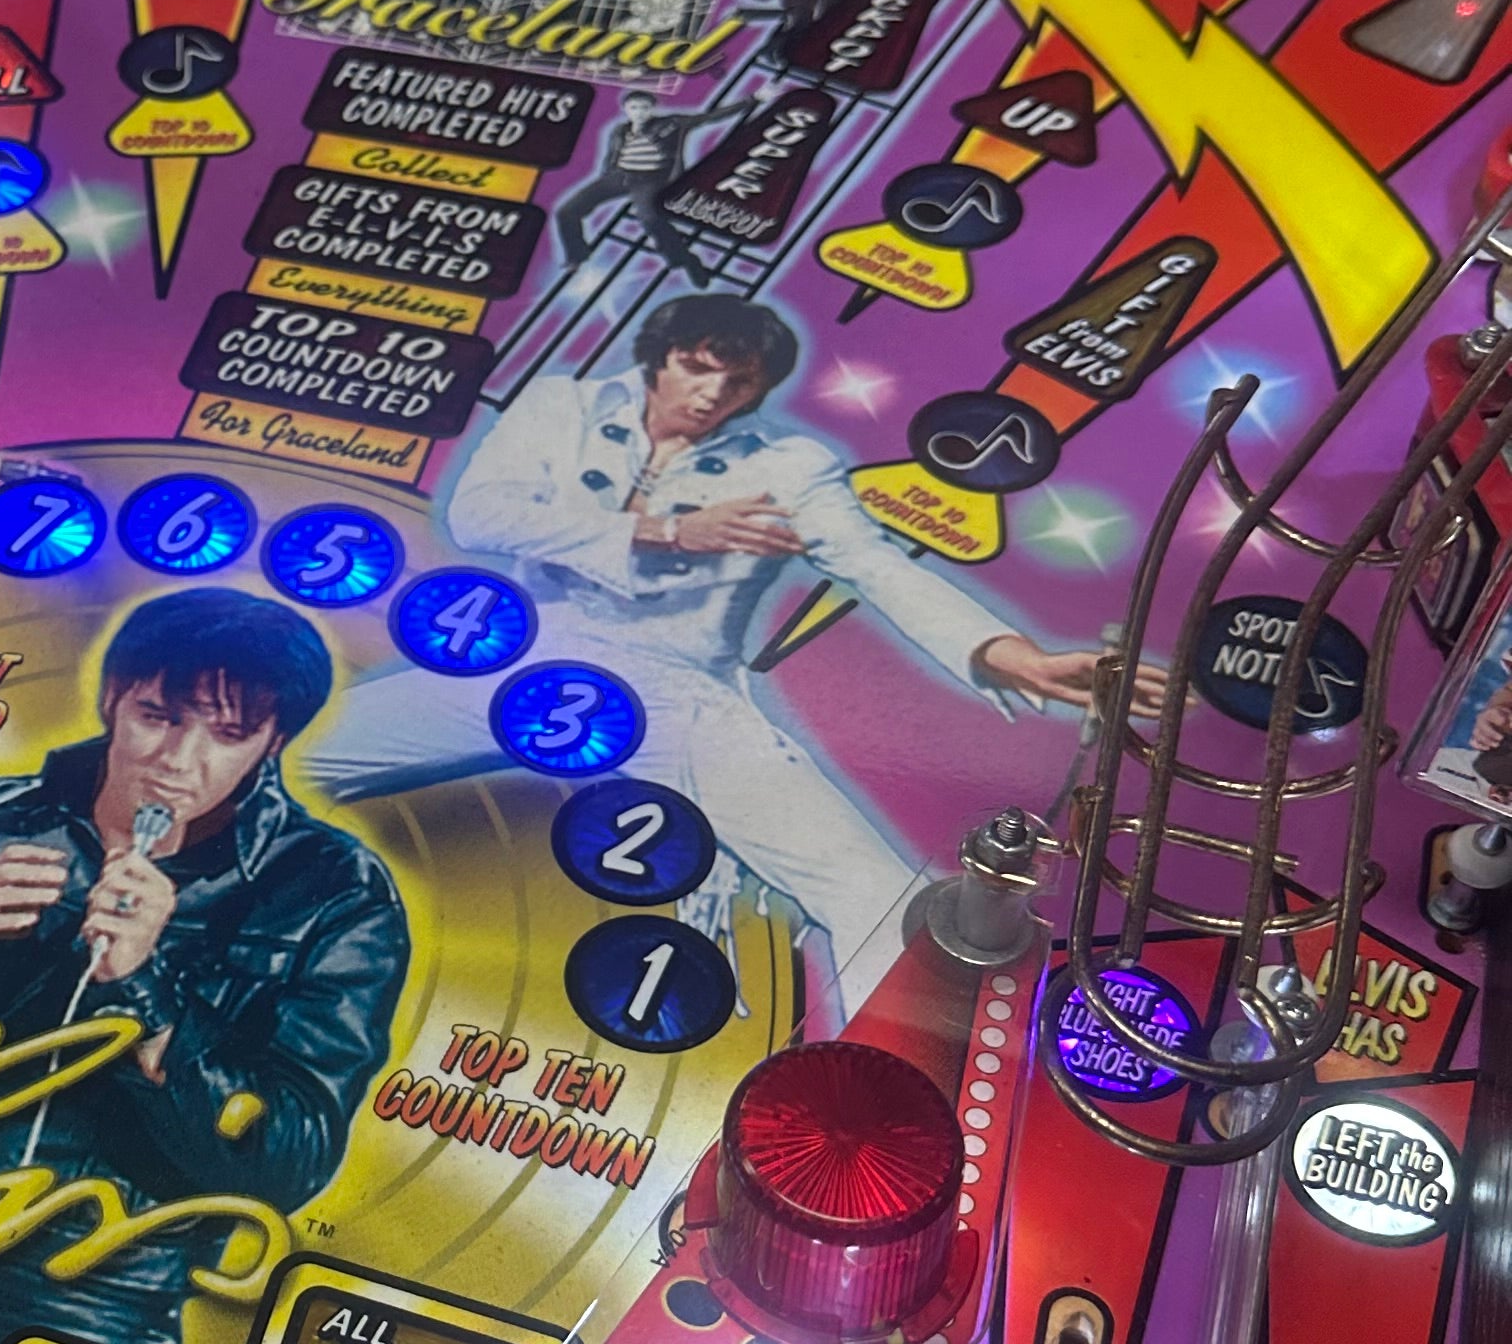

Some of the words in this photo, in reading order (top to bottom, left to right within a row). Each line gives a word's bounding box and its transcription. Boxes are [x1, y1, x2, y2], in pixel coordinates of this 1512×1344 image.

[333, 58, 495, 109] FEATURED
[499, 83, 578, 124] HITS
[340, 94, 526, 149] COMPLETED
[1001, 96, 1082, 137] UP
[351, 145, 496, 189] Collect
[714, 109, 818, 200] SUPER
[294, 175, 391, 216] GIFTS
[409, 197, 520, 238] FROM
[306, 206, 487, 256] E-L-V-I-S
[272, 227, 492, 285] COMPLETED
[827, 246, 955, 304] COUNTDOWN
[867, 242, 911, 266] TOP
[268, 268, 474, 330] Everything
[1097, 252, 1197, 334] GIFT
[217, 329, 456, 396] COUNTDOWN
[251, 306, 359, 341] TOP
[374, 330, 448, 362] 10
[1023, 333, 1126, 390] ELVIS
[1058, 318, 1131, 358] from
[217, 358, 434, 420] COMPLETED
[198, 401, 253, 438] For
[259, 412, 420, 469] Graceland
[10, 493, 73, 554] 7
[155, 491, 220, 556] 6
[858, 486, 983, 555] COUNTDOWN
[901, 484, 948, 513] TOP
[298, 523, 365, 585] 5
[434, 584, 501, 656] 4
[1228, 611, 1298, 647] SPOT
[533, 680, 604, 750] 3
[600, 803, 665, 876] 2
[626, 942, 675, 1023] 1
[439, 1023, 530, 1089] TOP
[534, 1047, 627, 1116] TEN
[1072, 1039, 1148, 1082] SHOES
[372, 1068, 658, 1190] COUNTDOWN
[1317, 1114, 1397, 1164] LEFT
[1398, 1141, 1438, 1175] the
[1304, 1153, 1442, 1215] BUILDING
